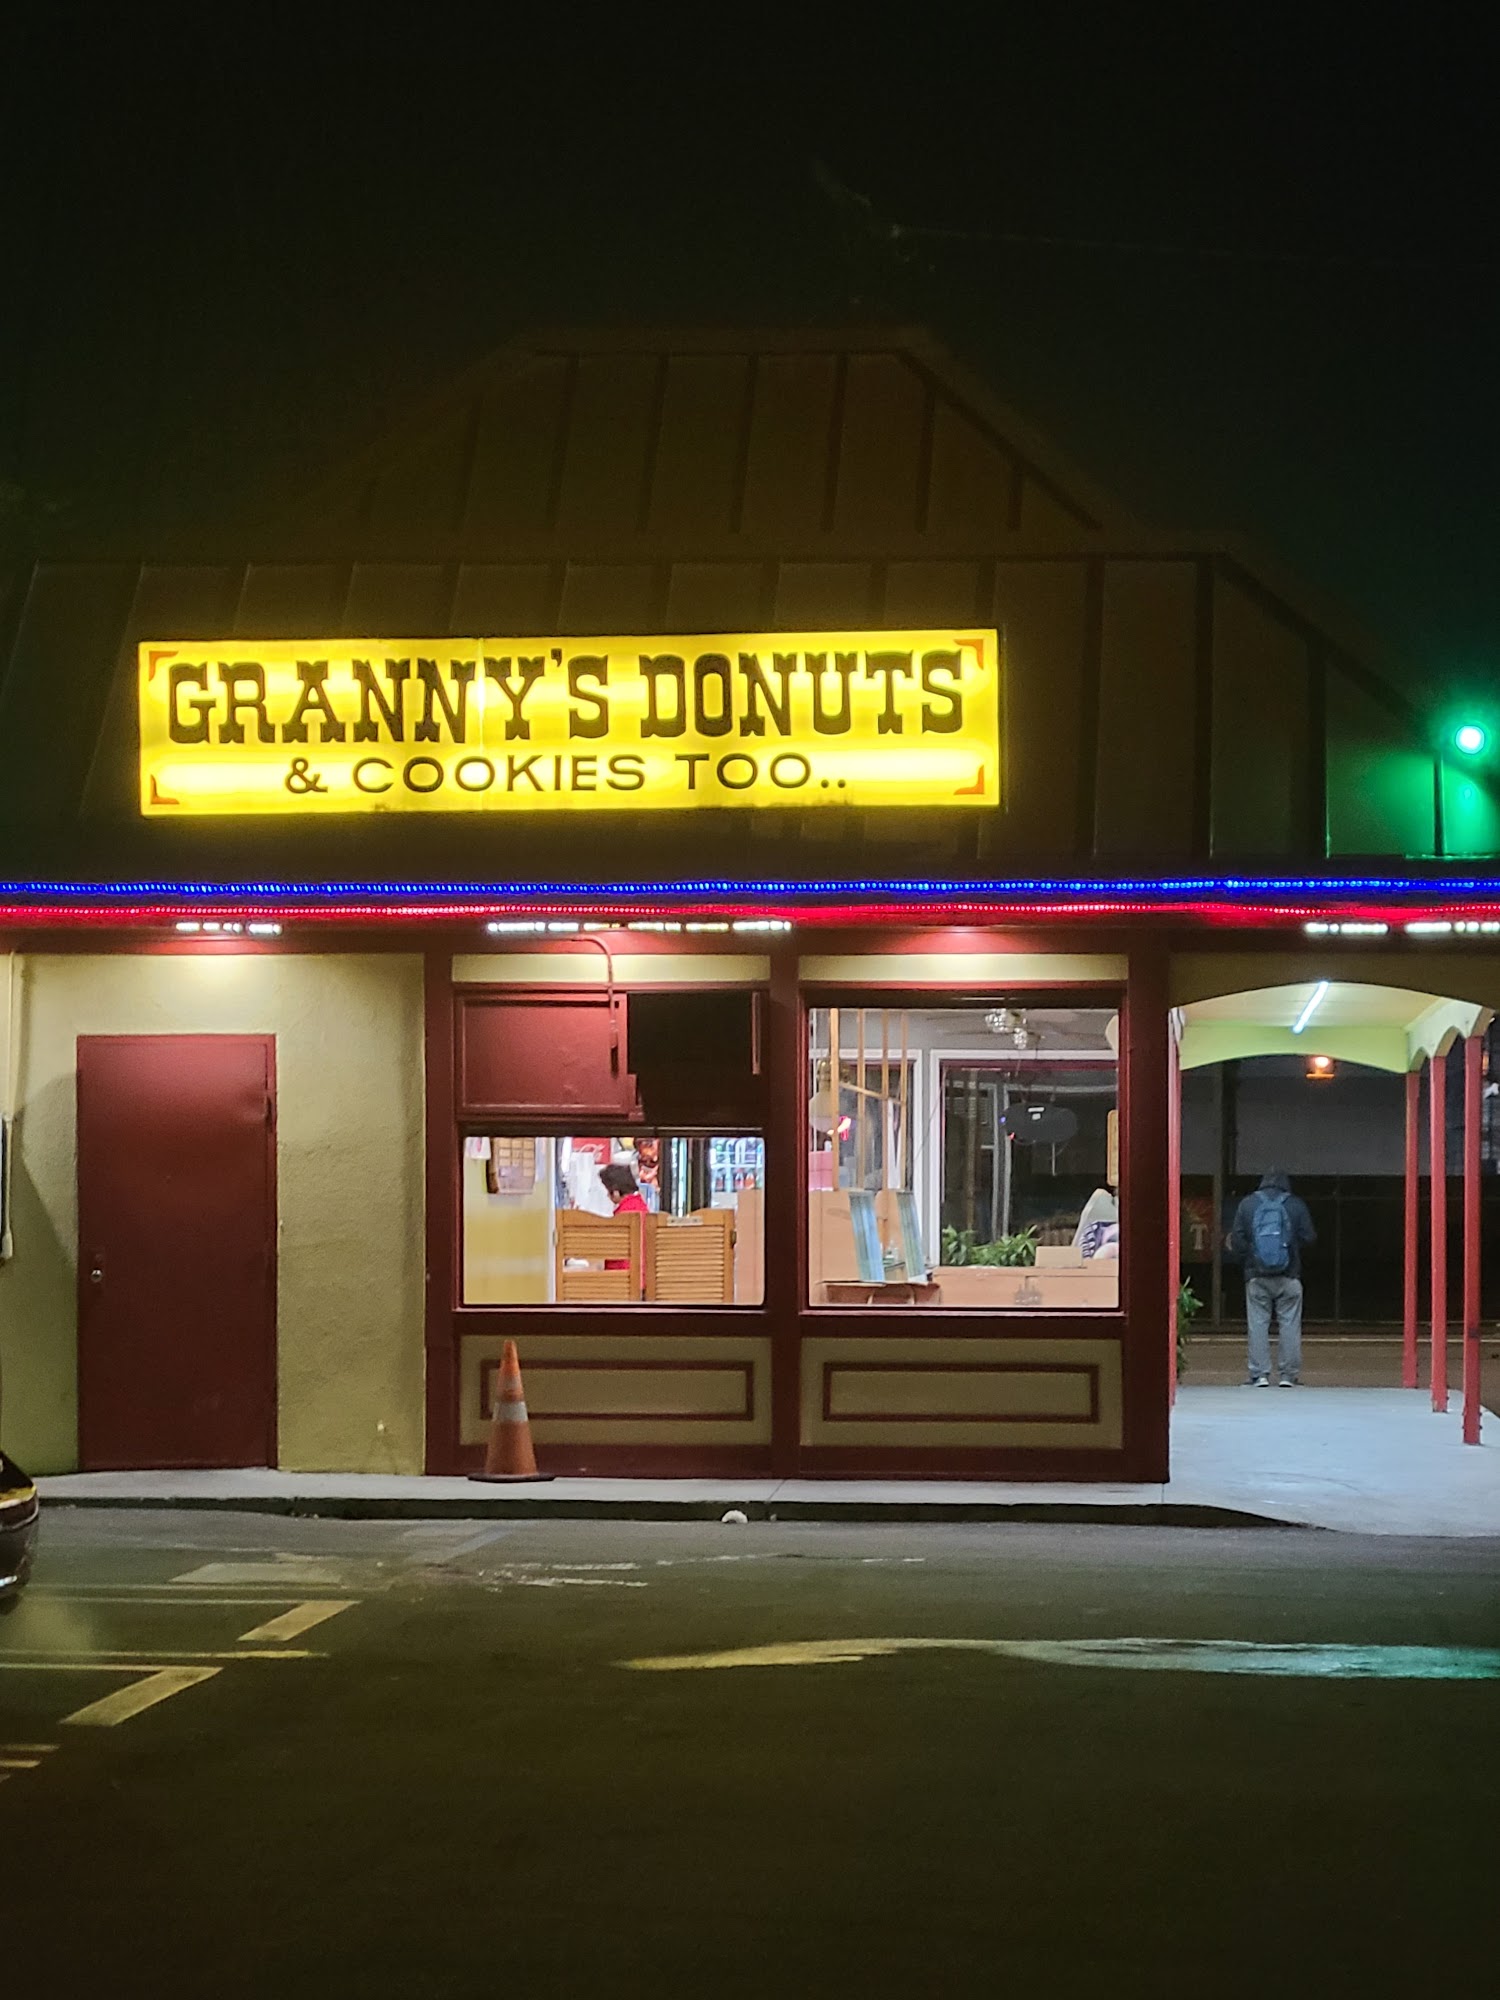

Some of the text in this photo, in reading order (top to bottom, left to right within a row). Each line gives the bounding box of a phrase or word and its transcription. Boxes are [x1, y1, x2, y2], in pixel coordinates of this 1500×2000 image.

[169, 648, 963, 744] GRANNY'S DONUTS
[285, 752, 847, 793] & COOKIES TOO..
